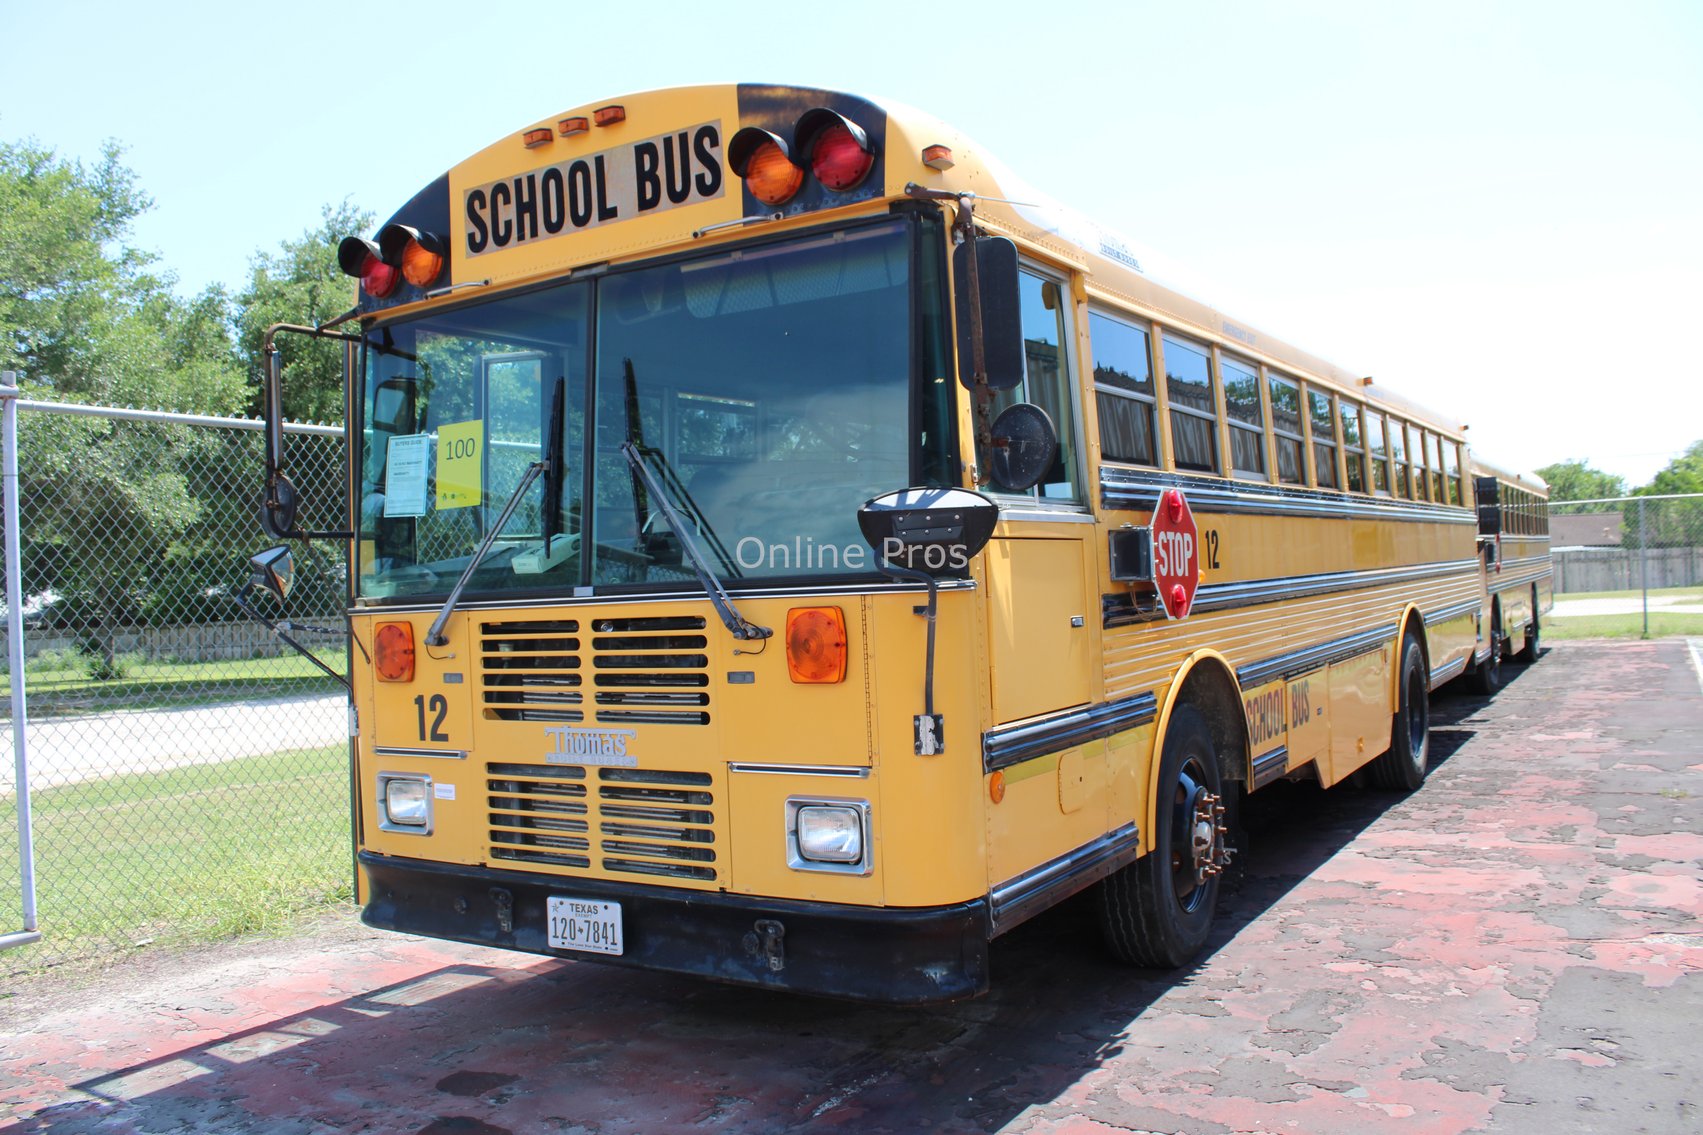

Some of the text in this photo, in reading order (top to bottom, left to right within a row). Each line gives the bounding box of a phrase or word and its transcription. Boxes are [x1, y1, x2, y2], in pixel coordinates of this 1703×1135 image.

[466, 125, 722, 254] SCHOOL BUS
[446, 437, 476, 460] 100
[1158, 530, 1193, 577] STOP
[1205, 529, 1220, 570] 12
[414, 693, 449, 742] 12
[1246, 679, 1310, 746] SCHOOL BUS
[544, 725, 637, 757] Thomas
[569, 903, 599, 915] TEXAS
